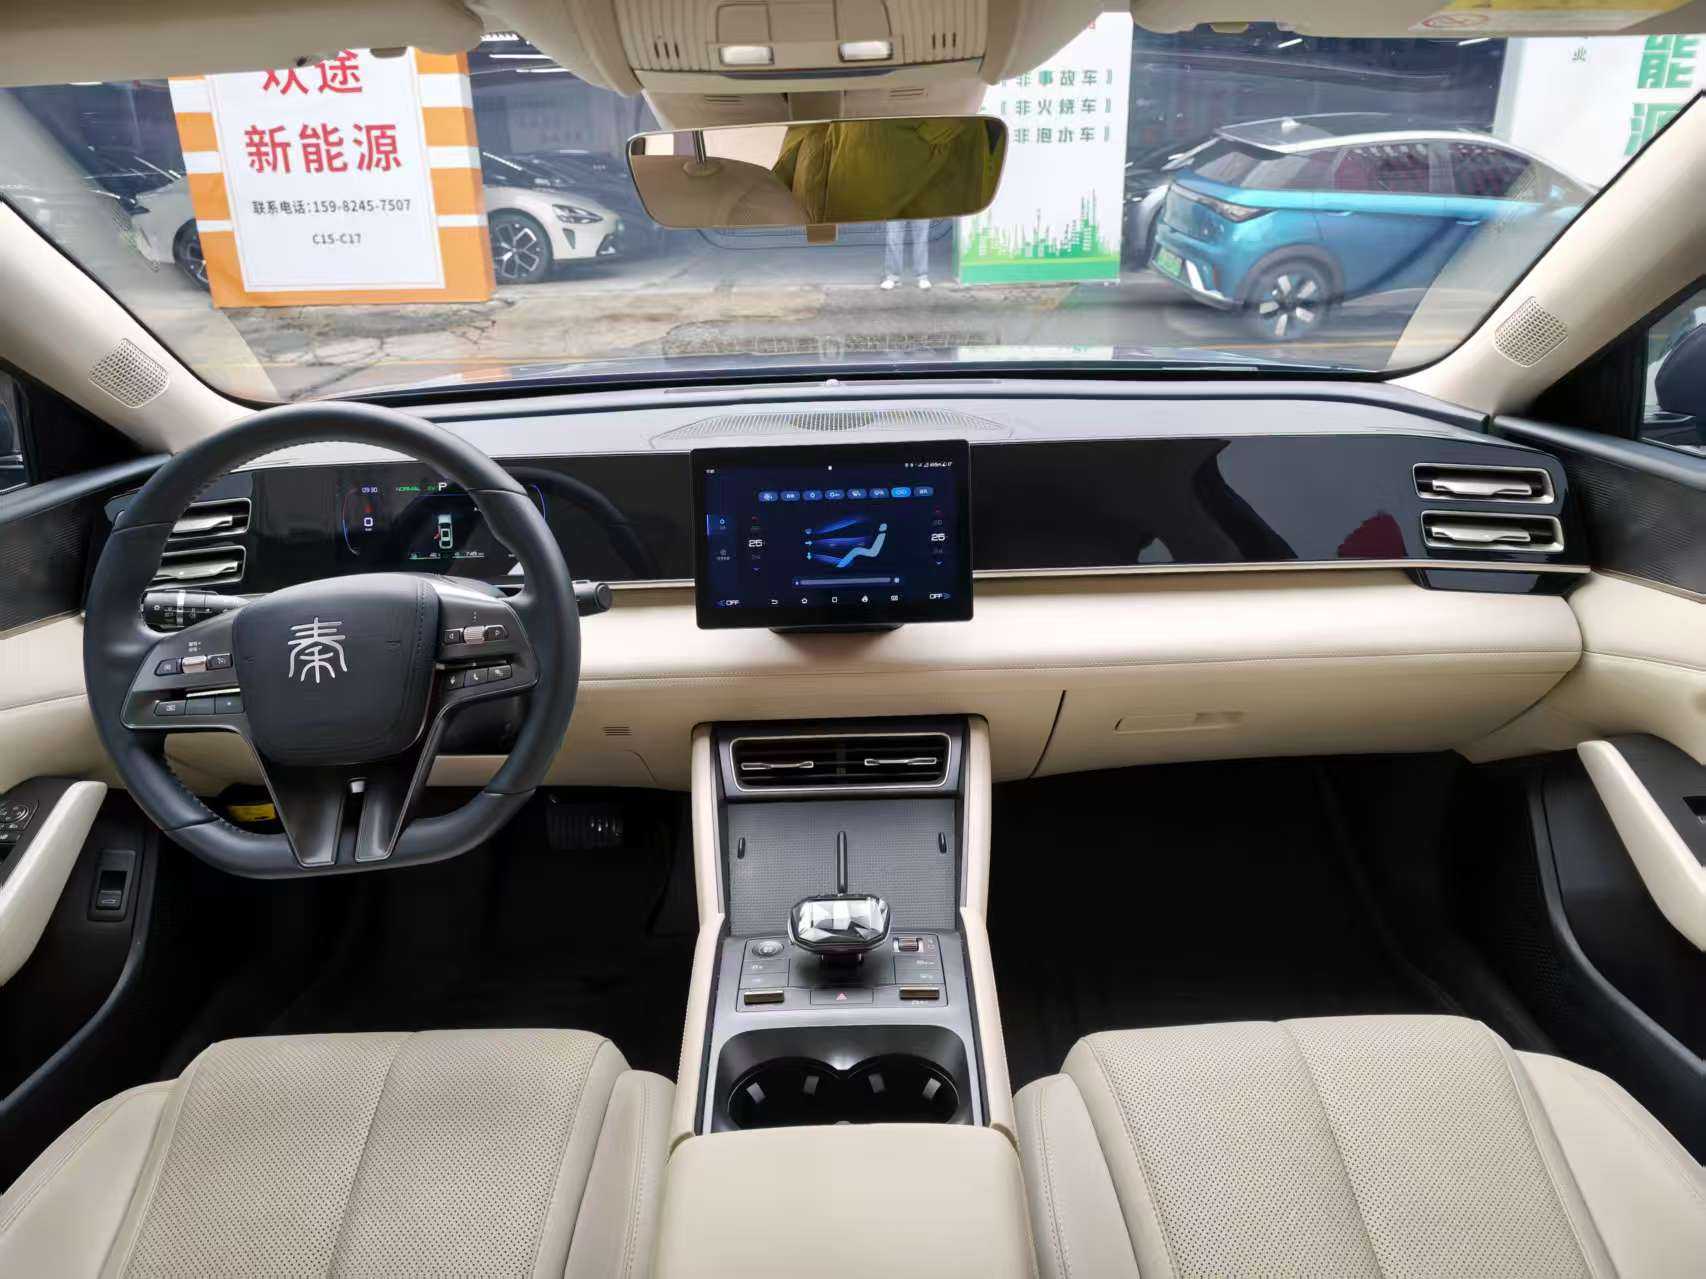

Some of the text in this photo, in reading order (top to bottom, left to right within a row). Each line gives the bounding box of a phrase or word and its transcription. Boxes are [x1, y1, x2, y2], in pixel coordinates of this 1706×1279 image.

[244, 122, 402, 174] 新能源
[312, 232, 362, 245] C15-C17
[438, 482, 448, 492] P
[363, 517, 374, 527] 0
[288, 616, 348, 683] 秦
